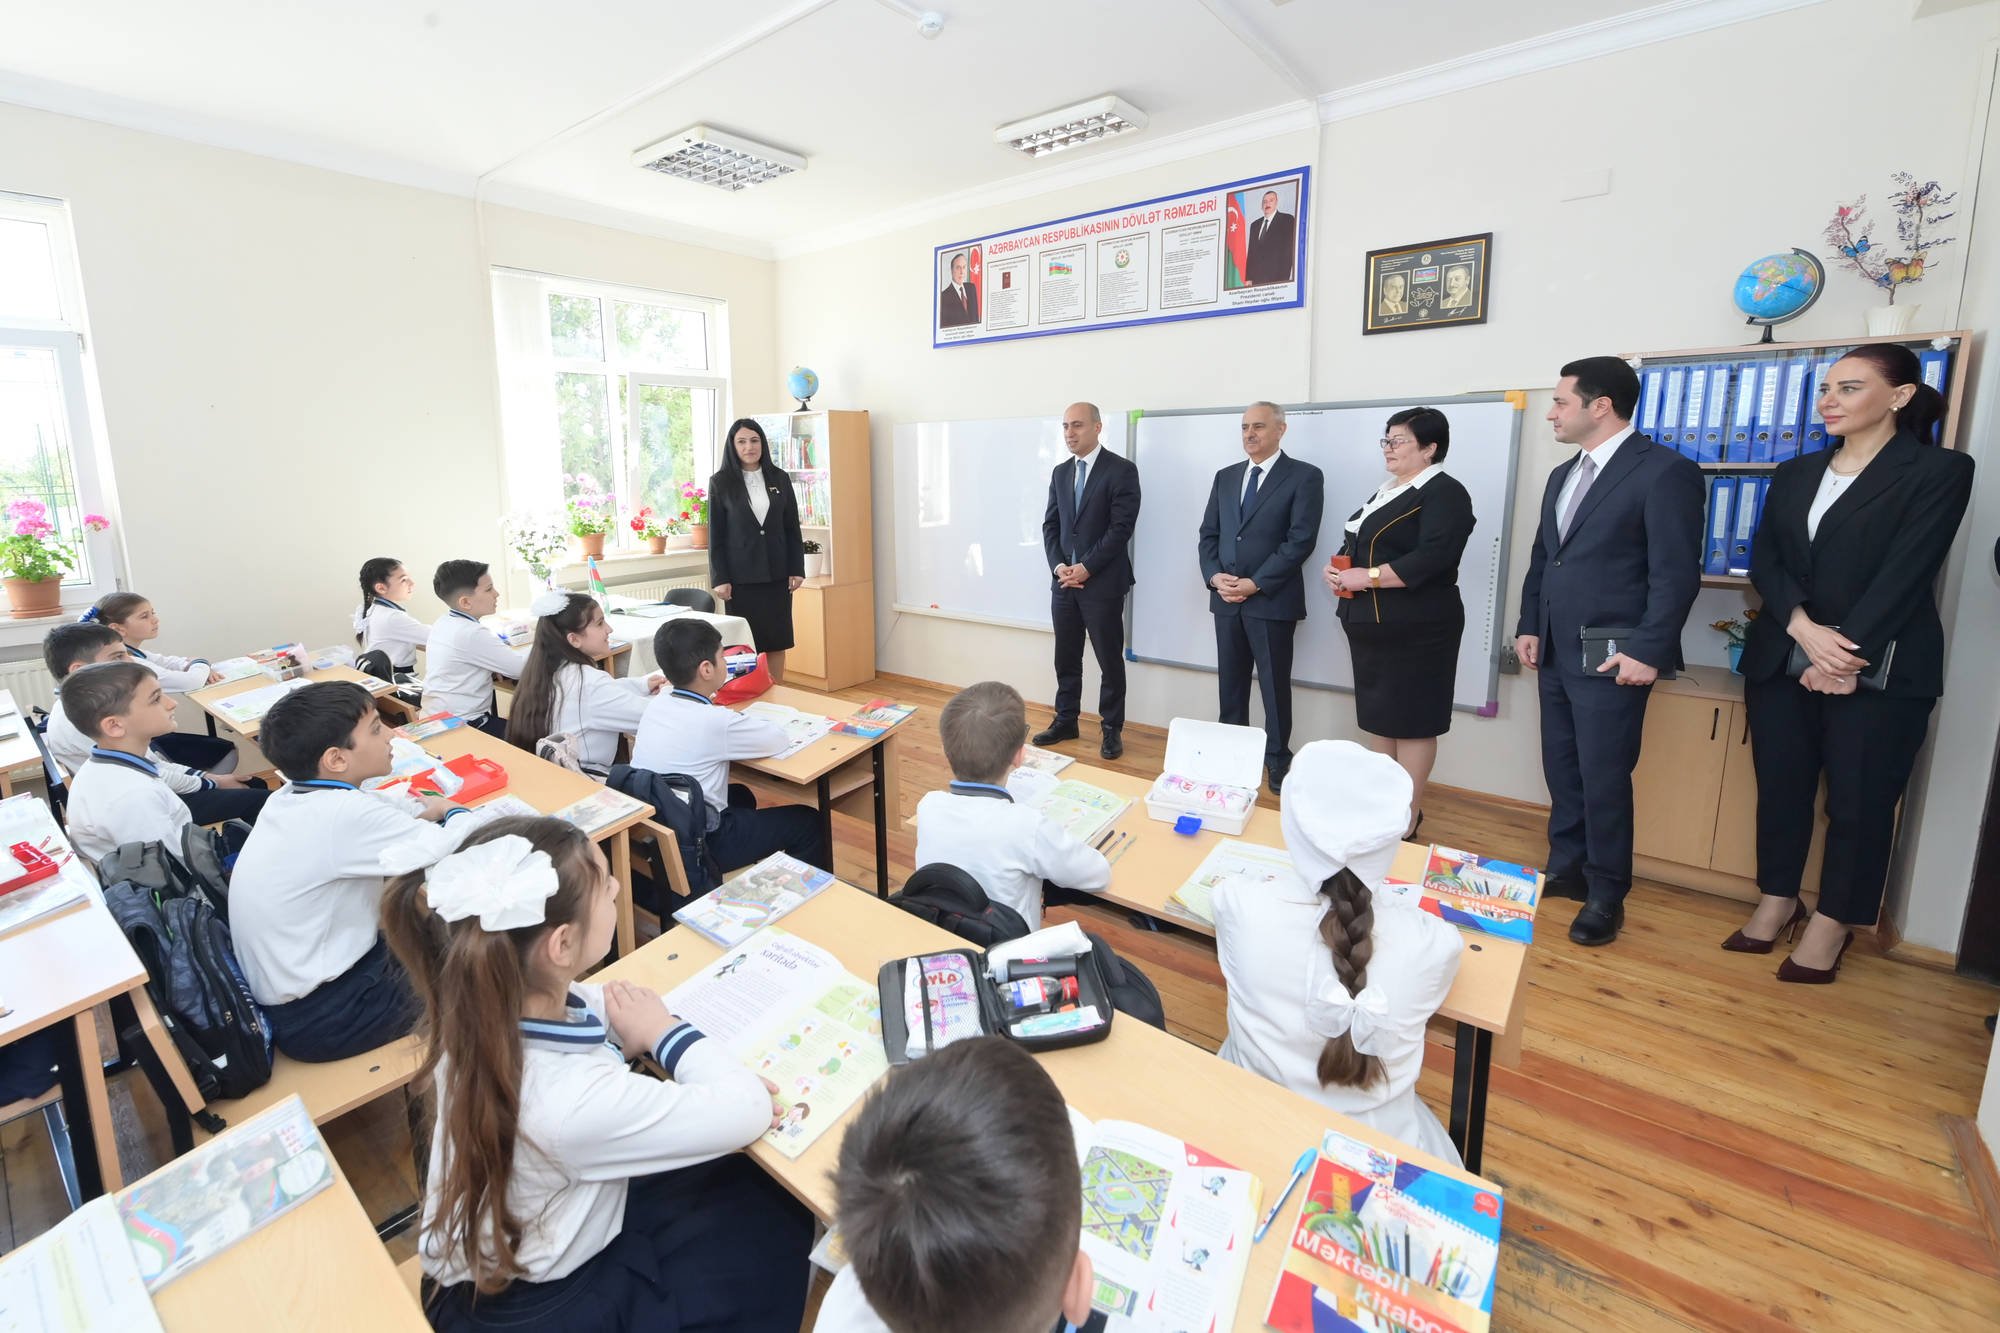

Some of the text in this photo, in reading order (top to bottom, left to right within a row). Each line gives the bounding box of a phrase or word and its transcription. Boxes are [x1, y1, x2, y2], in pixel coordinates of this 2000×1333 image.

[988, 235, 1040, 255] AZƏRBAYCAN
[1042, 218, 1120, 245] RESPUBLİKASININ
[1122, 209, 1161, 229] DÖVLƏT
[1164, 196, 1217, 221] RƏMZLƏRİ
[1296, 1228, 1411, 1297] Məktəbli
